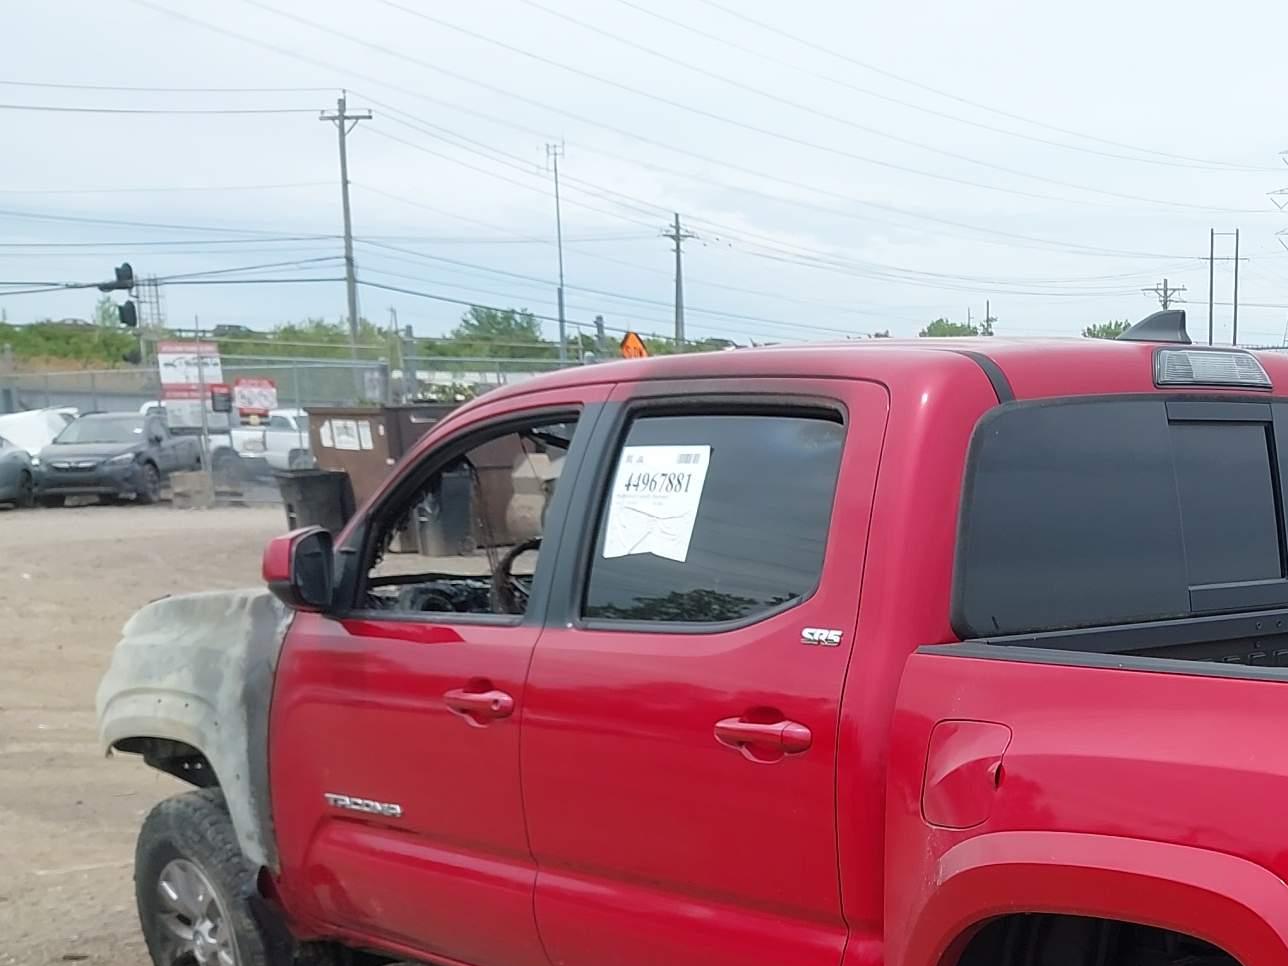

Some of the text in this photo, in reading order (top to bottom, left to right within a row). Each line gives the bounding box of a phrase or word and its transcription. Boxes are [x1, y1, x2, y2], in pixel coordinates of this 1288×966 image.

[624, 472, 692, 493] 44967881
[801, 627, 844, 646] SR5
[323, 792, 403, 818] TACOMA
